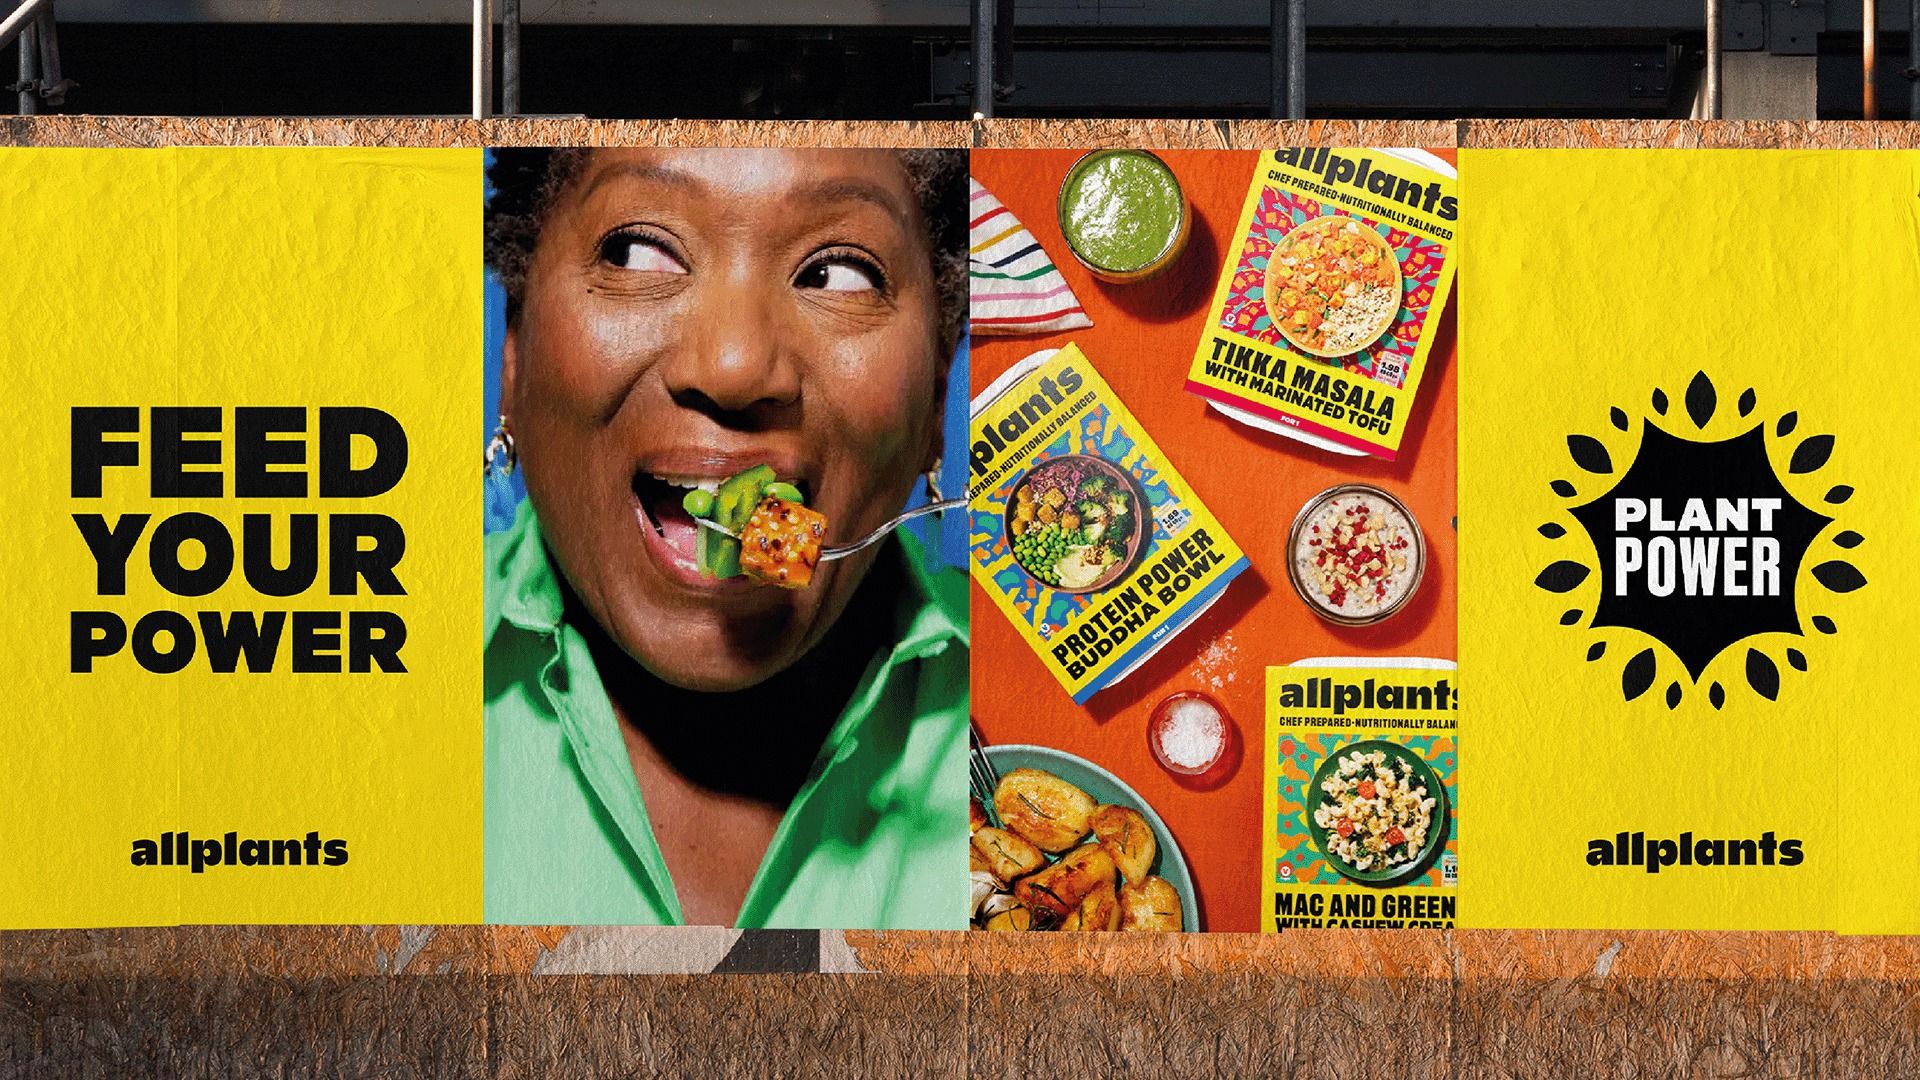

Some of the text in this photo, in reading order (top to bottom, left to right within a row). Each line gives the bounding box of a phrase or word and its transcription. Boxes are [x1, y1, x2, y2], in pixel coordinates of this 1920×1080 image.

[1268, 169, 1292, 184] CHEF
[1407, 217, 1453, 241] BALANCED
[1274, 147, 1458, 221] allplants
[1056, 391, 1097, 427] BALANCED
[1205, 360, 1246, 387] WITH
[1249, 374, 1345, 419] MARINATED
[1347, 411, 1391, 436] TOFU
[1212, 337, 1395, 420] TIKKA MASALA
[70, 406, 409, 498] FEED
[969, 366, 1083, 477] plants
[1615, 498, 1782, 531] PLANT
[71, 511, 409, 597] YOUR
[1615, 535, 1780, 597] POWER
[1051, 528, 1214, 667] PROTEIN POWER
[1066, 549, 1225, 680] BUDDHA BOWL
[70, 610, 409, 674] POWER
[1279, 677, 1458, 715] allplant
[1280, 717, 1303, 726] CHEF
[1426, 719, 1458, 729] BALAN
[130, 831, 349, 874] allplants
[1585, 831, 1805, 874] allplants
[1275, 893, 1456, 919] MAC AND GREEN
[1275, 917, 1322, 933] WITH
